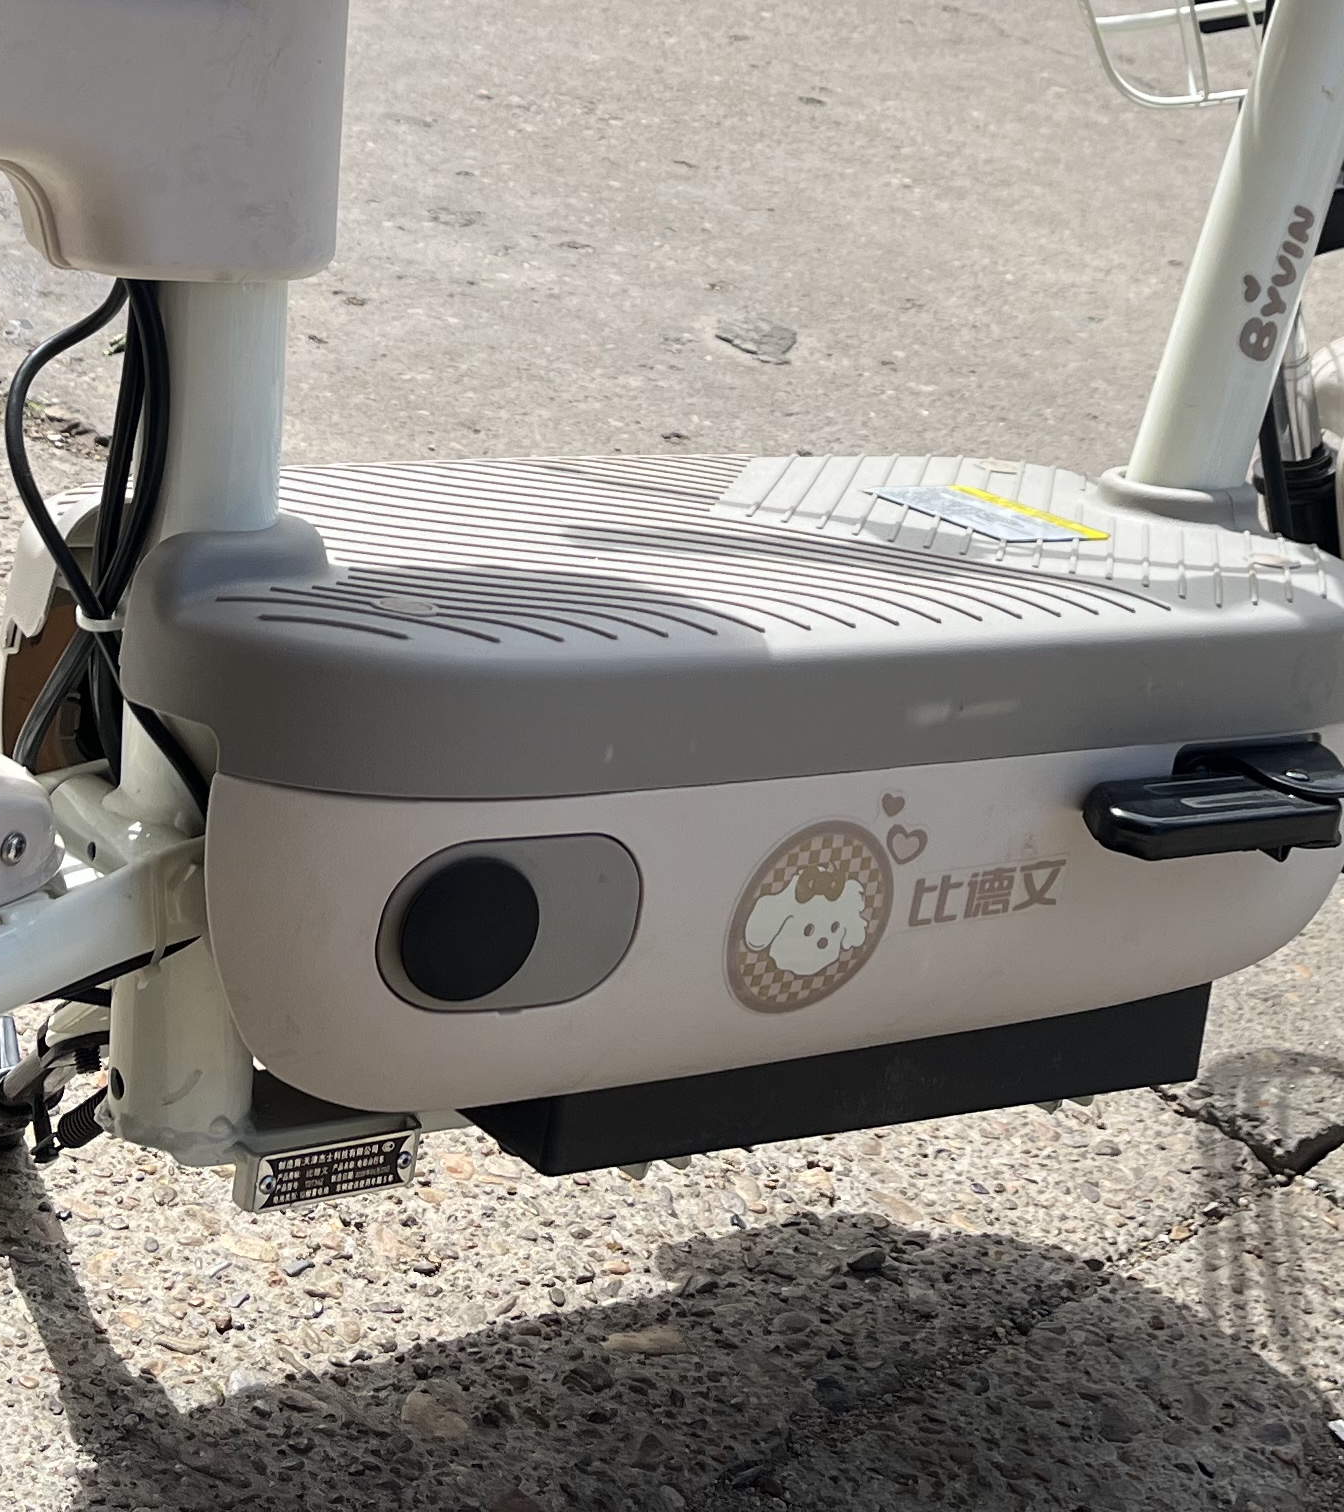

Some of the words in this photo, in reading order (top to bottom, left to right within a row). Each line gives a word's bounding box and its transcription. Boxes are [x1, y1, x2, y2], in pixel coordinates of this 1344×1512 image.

[1239, 205, 1315, 362] BYVIN
[907, 859, 1067, 927] 比德文
